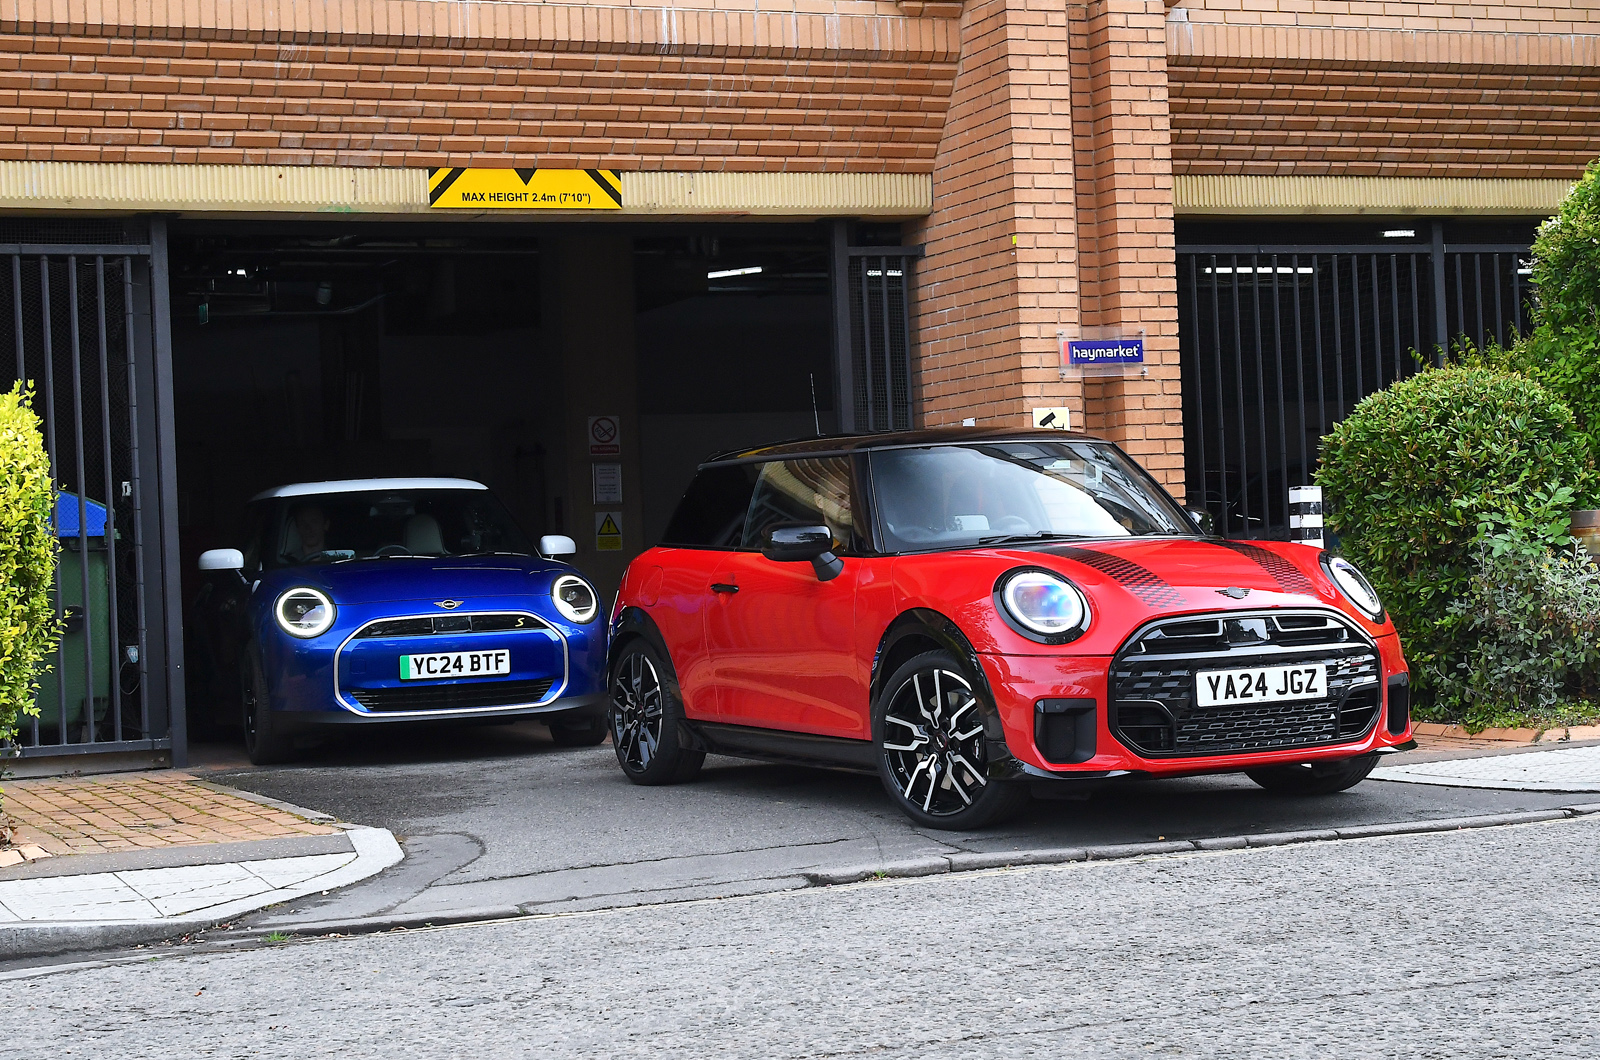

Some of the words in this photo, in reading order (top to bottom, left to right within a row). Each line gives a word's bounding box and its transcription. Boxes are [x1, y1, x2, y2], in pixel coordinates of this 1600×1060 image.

[462, 192, 486, 202] MAX
[488, 192, 529, 202] HEIGHT
[532, 192, 556, 202] 2.4m
[559, 192, 591, 204] (7'10")
[1072, 344, 1139, 361] haymarket
[515, 617, 525, 627] S
[413, 655, 464, 675] YC24
[469, 652, 506, 672] BTF
[1207, 672, 1268, 700] YA24
[1276, 669, 1318, 695] JGZ
